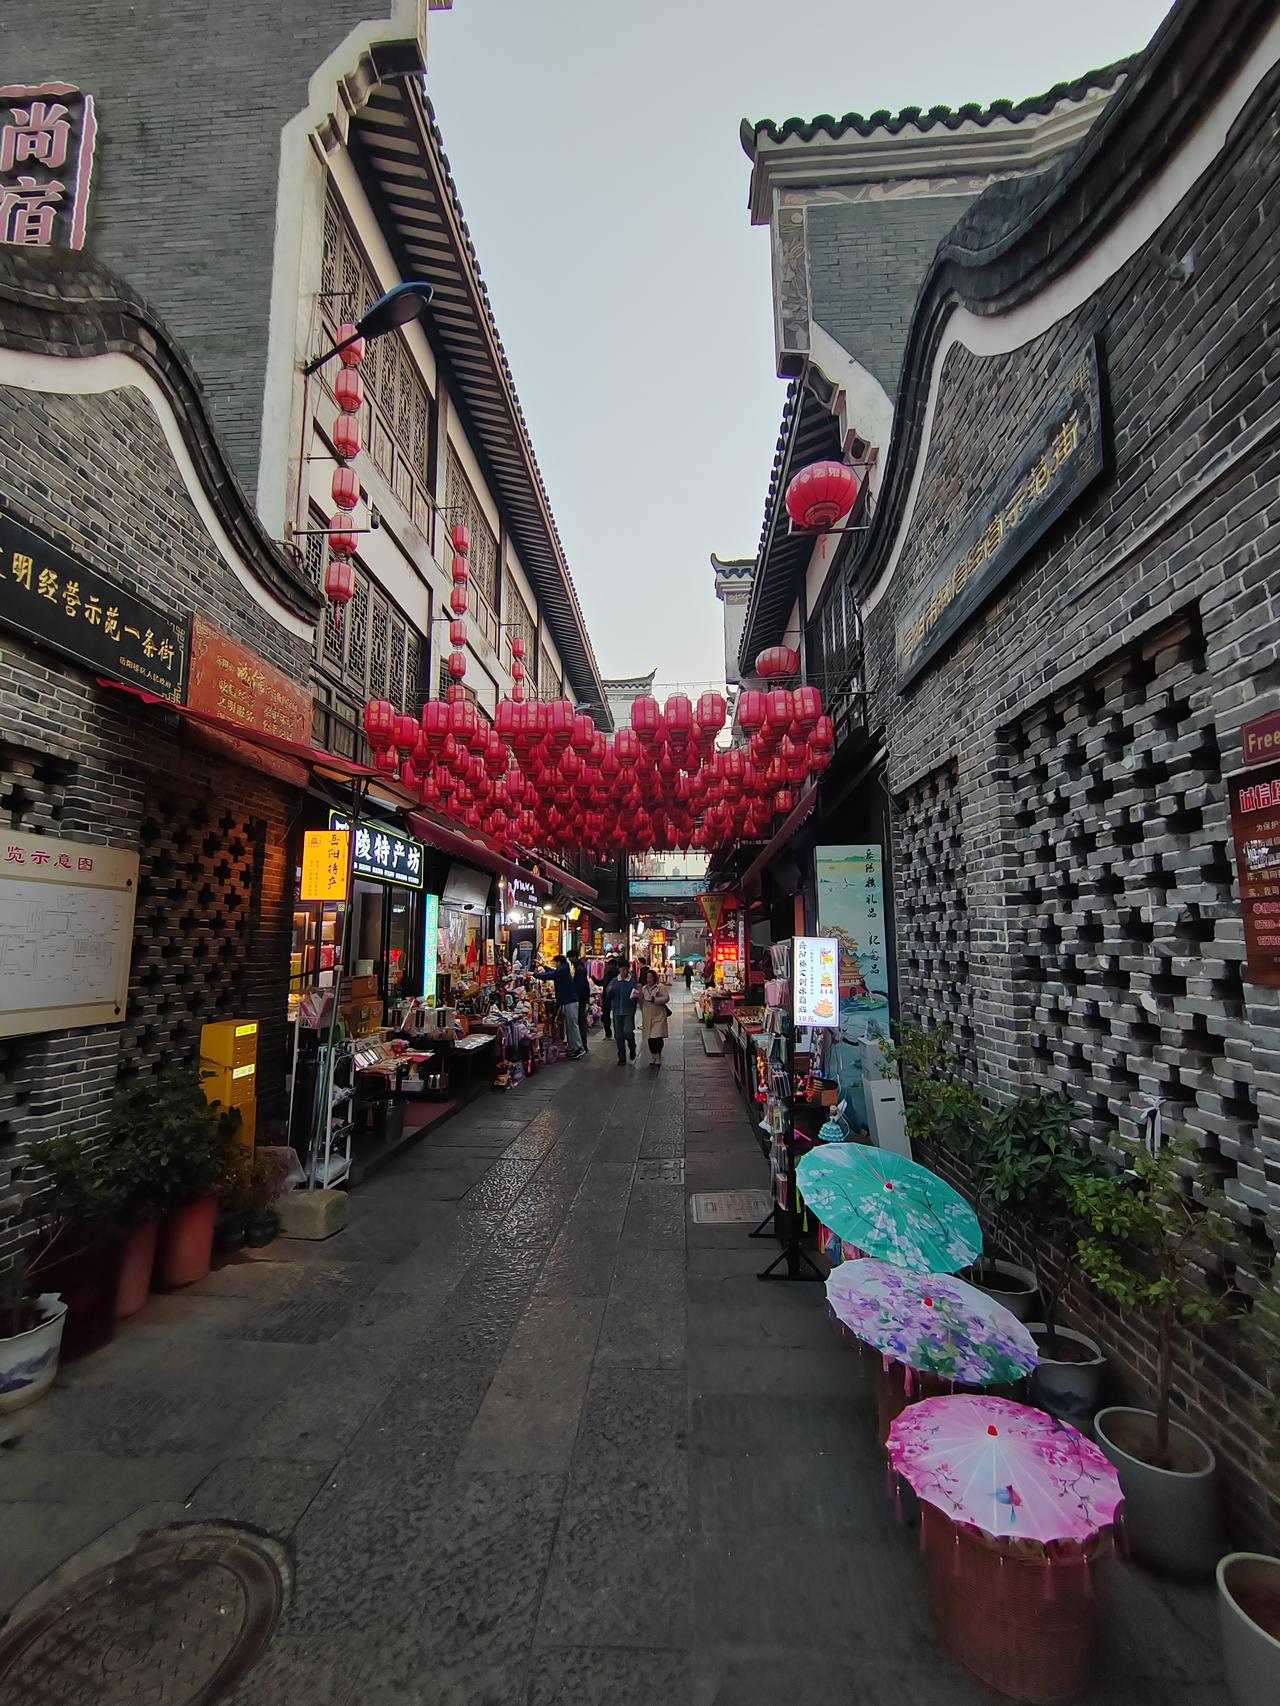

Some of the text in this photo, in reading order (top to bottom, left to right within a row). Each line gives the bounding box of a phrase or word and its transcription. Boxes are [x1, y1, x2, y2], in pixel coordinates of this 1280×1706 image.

[0, 547, 176, 671] 明经营示范一条街
[327, 834, 340, 890] 岳阳特产
